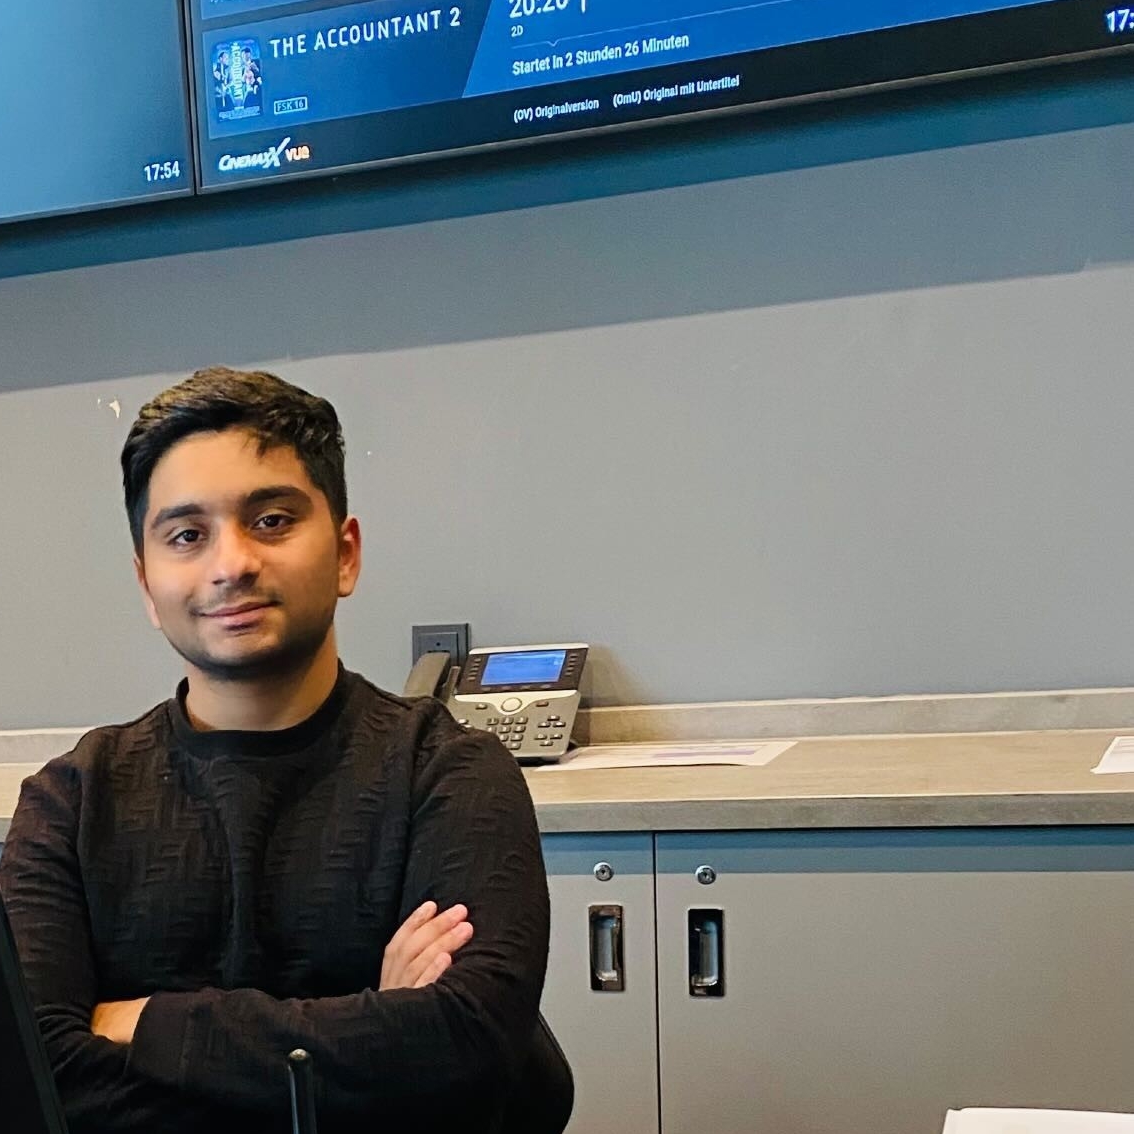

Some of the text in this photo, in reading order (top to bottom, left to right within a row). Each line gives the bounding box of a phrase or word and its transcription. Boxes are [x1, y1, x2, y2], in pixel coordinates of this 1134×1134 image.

[269, 6, 461, 58] THE ACCOUNTANT 2
[511, 25, 524, 38] 2D
[512, 35, 690, 76] Startet in 2 Stunden 26 Minuten
[277, 99, 304, 112] FSK 16
[513, 74, 740, 123] (OV) Originalversion (OmU) Original mit Untertitel
[144, 160, 180, 182] 17:54
